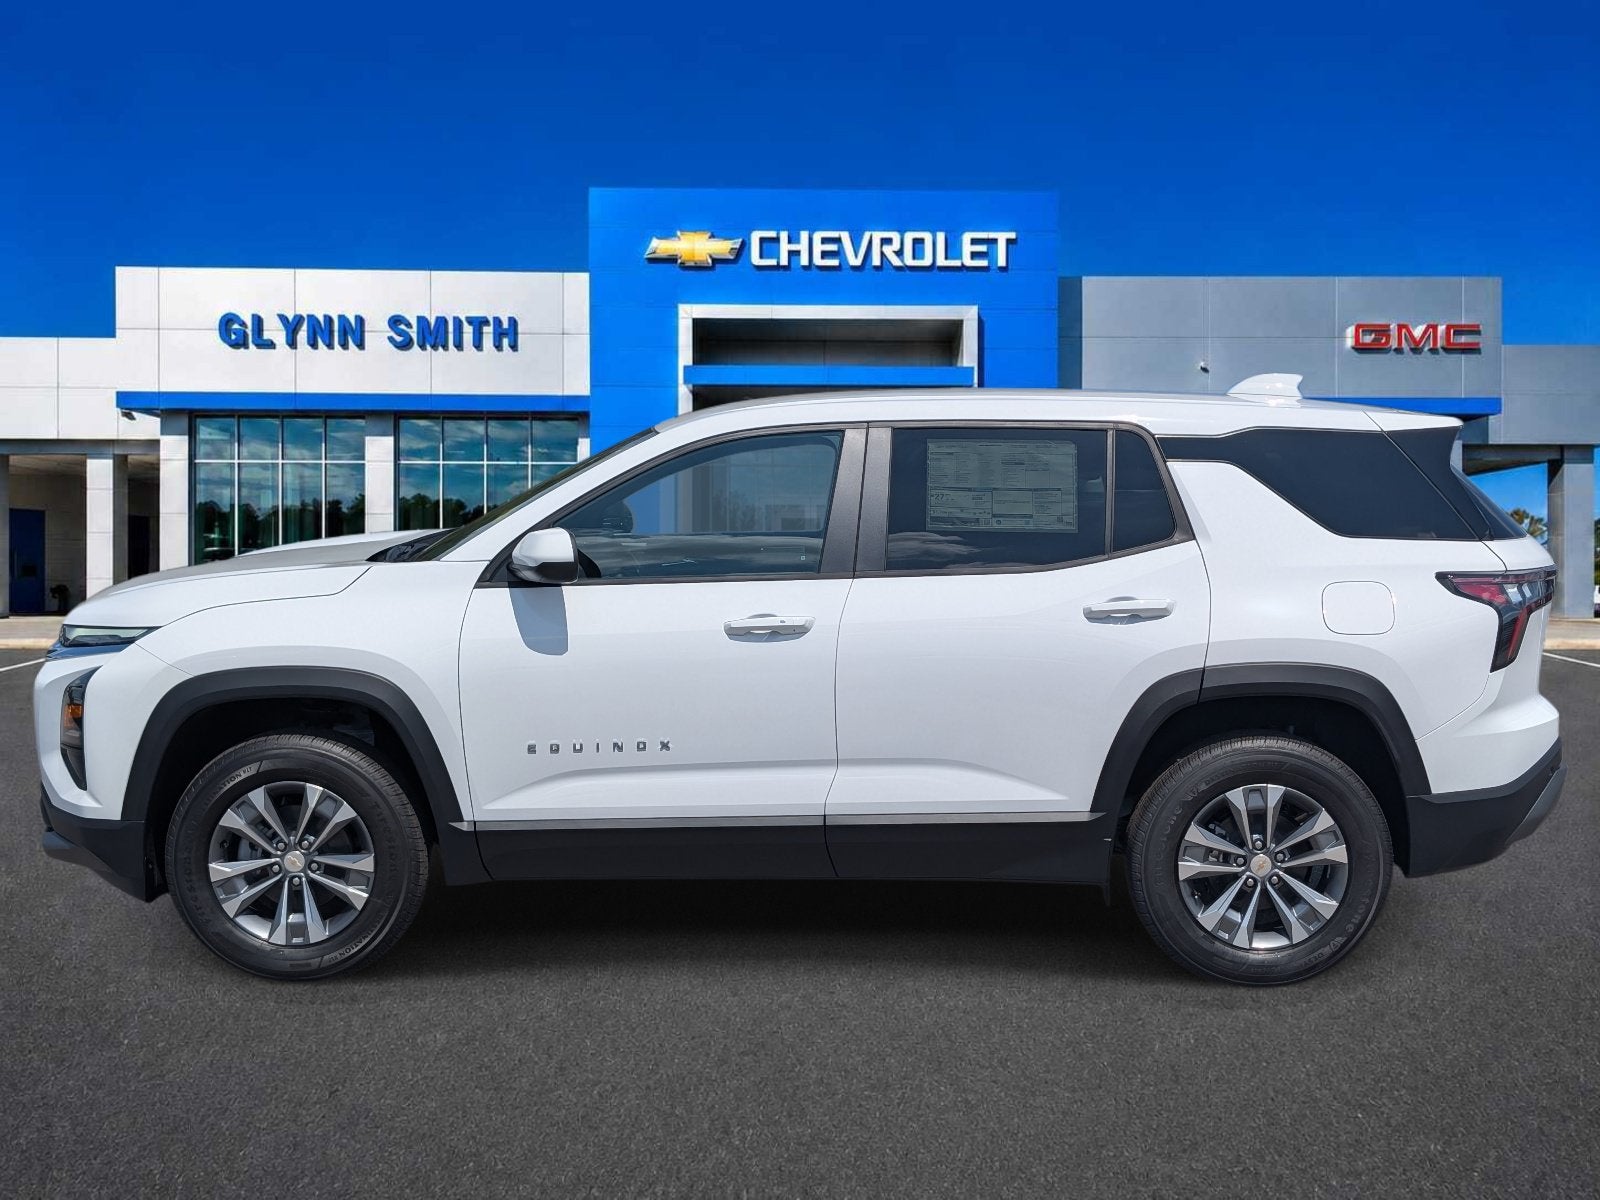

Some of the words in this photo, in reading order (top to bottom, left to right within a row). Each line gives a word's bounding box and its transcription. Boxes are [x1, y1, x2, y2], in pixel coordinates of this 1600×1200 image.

[750, 230, 1017, 269] CHEVROLET
[218, 312, 367, 351] GLYNN
[387, 314, 519, 352] SMITH
[1350, 323, 1482, 352] GMC
[526, 738, 671, 755] EQUINOX
